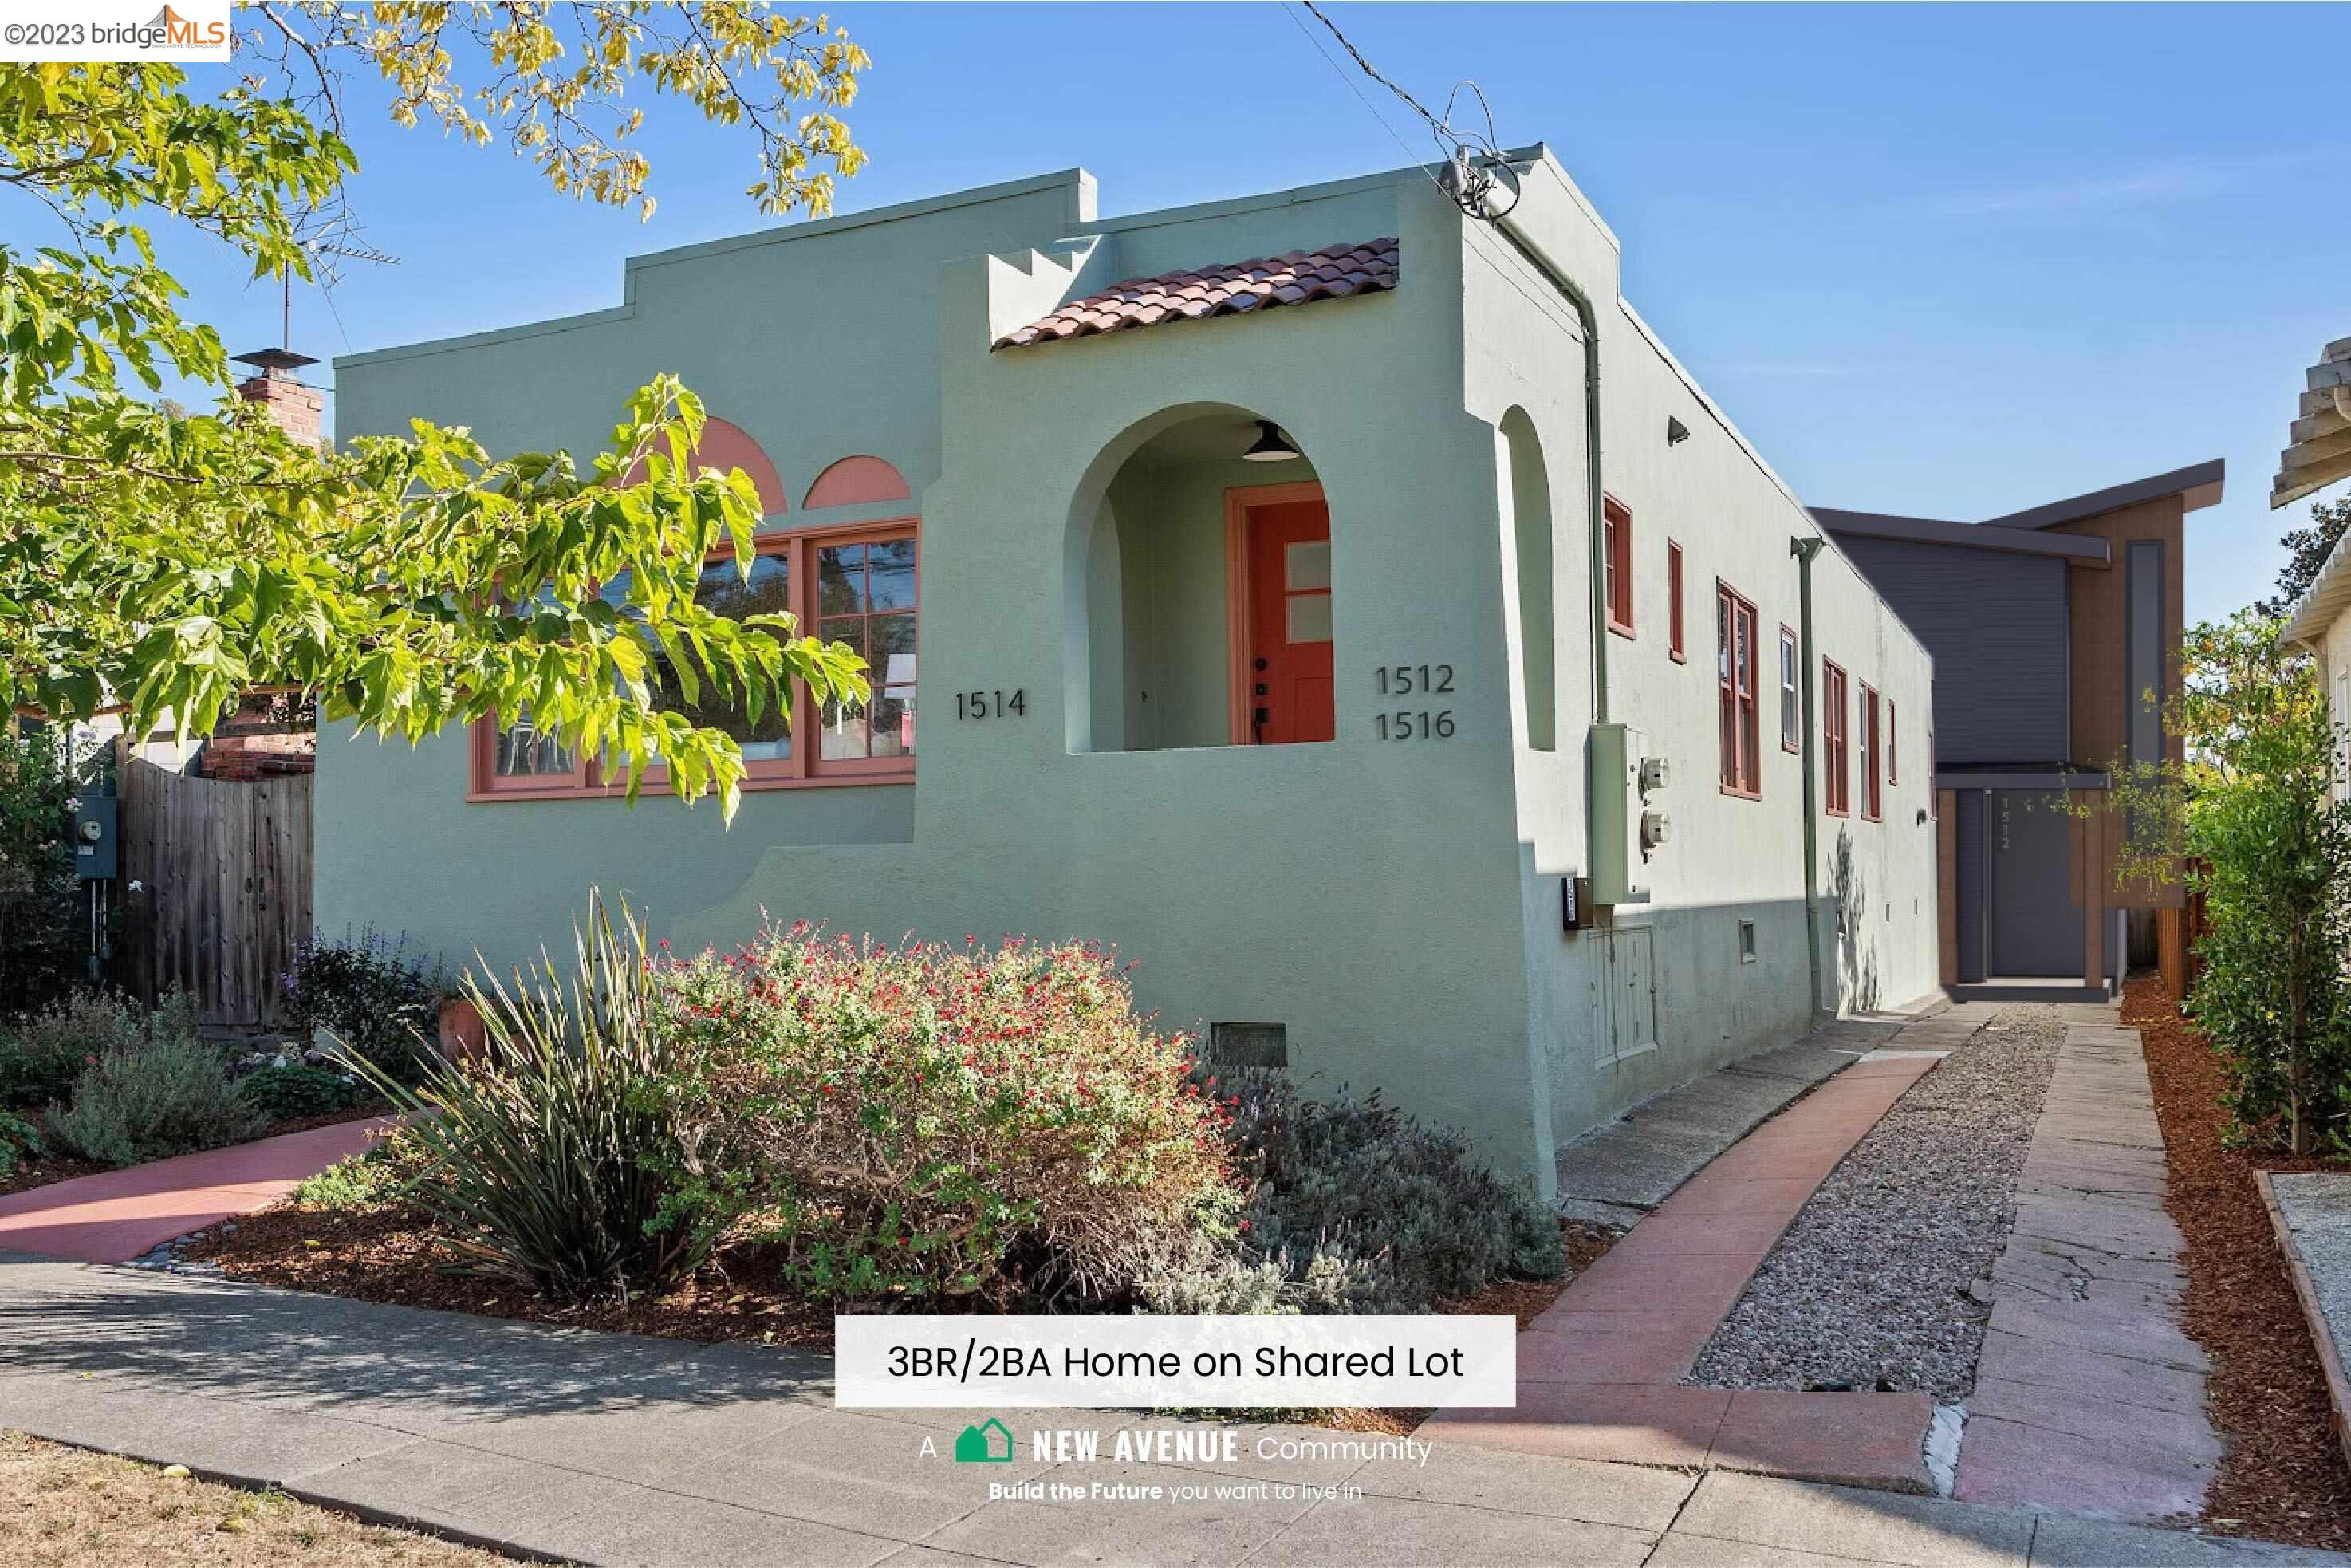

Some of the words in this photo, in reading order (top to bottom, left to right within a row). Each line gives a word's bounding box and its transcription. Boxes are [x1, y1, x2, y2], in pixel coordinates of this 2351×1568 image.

[1376, 664, 1455, 695] 1512
[956, 687, 1026, 721] 1514
[1376, 710, 1455, 741] 1516
